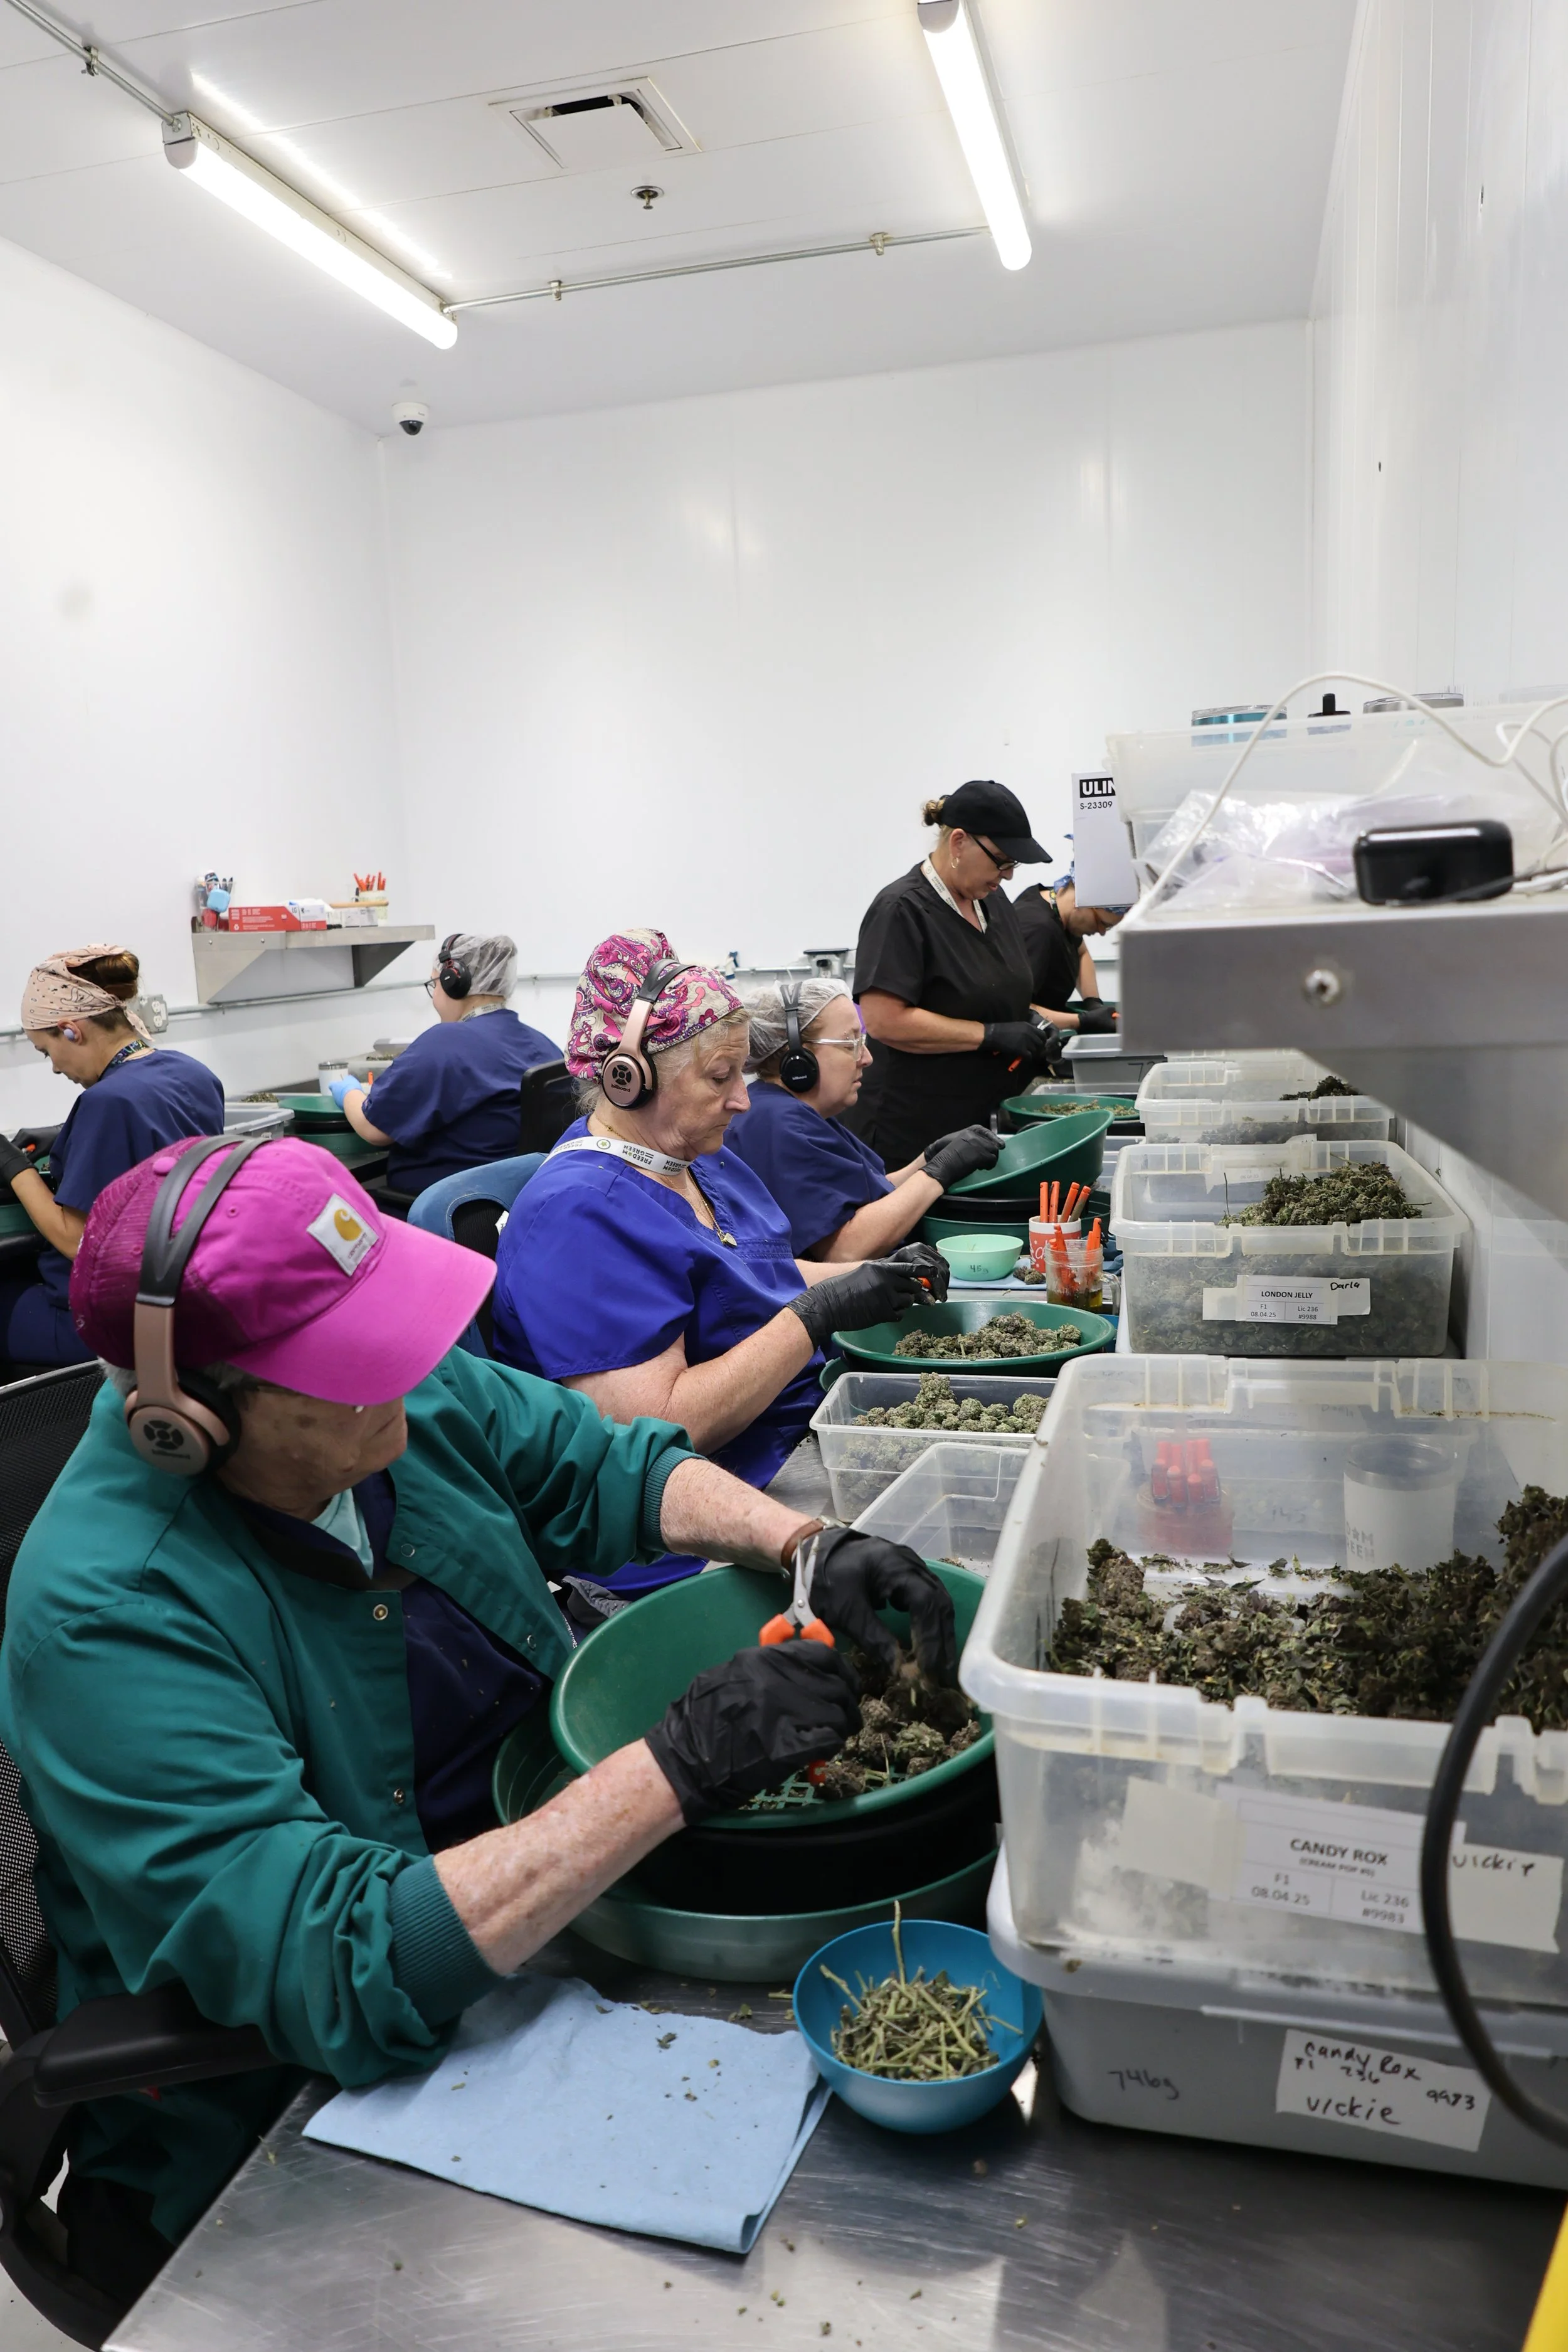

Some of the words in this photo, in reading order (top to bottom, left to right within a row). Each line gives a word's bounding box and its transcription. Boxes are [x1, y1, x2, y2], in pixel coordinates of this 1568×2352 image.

[1080, 801, 1113, 810] S-23309
[611, 1084, 630, 1092] billboard
[623, 1145, 645, 1156] GREEN
[1330, 1281, 1360, 1291] Darla
[1290, 1838, 1349, 1858] CANDY
[1352, 1849, 1389, 1865] ROX
[1251, 1886, 1310, 1905] 08.04.25
[1383, 1892, 1409, 1908] 236
[1362, 1907, 1404, 1924] #9983
